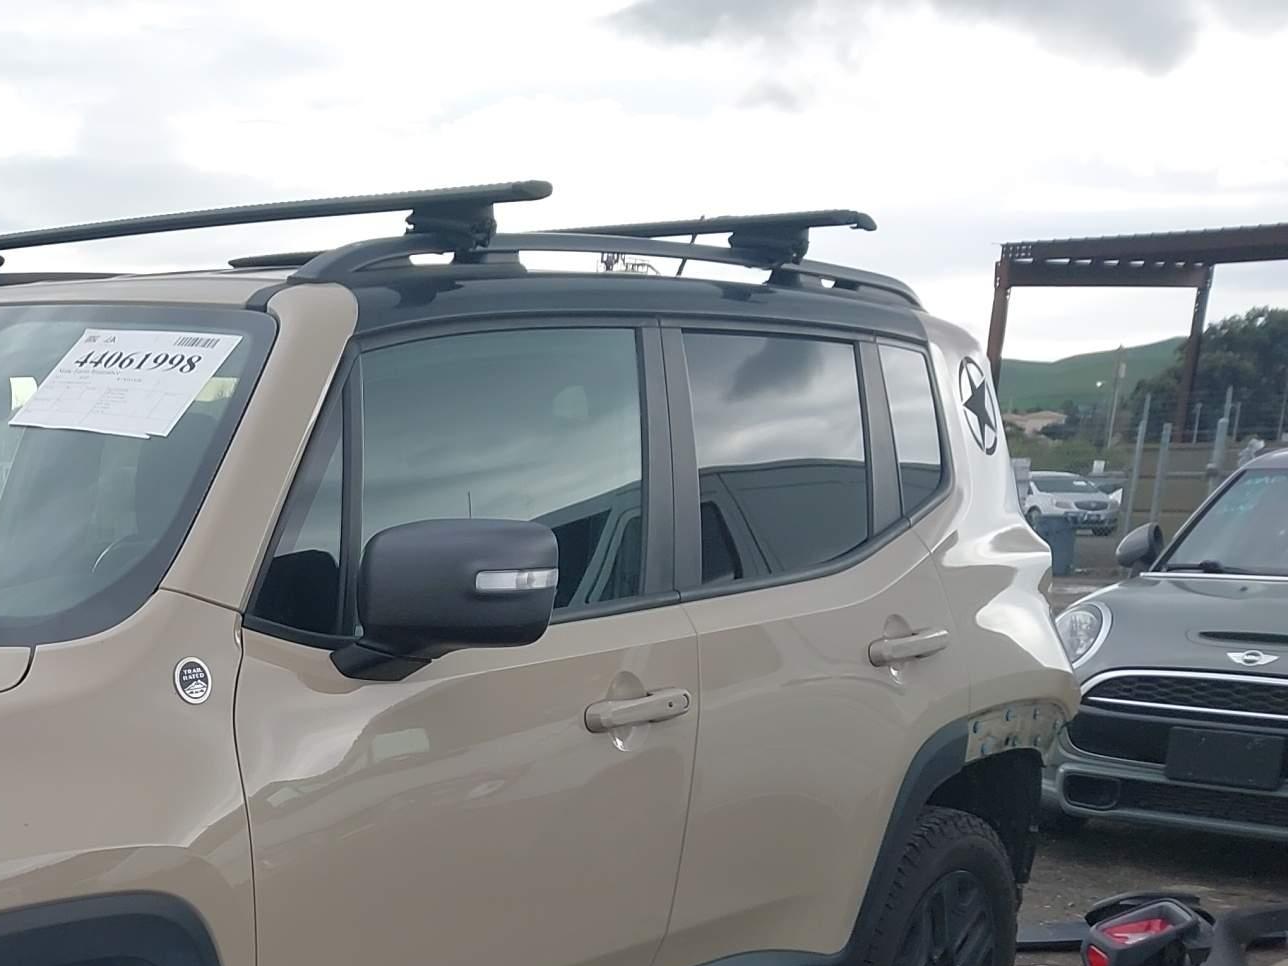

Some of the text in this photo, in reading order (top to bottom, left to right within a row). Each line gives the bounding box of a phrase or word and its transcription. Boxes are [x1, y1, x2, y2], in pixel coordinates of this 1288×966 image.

[74, 350, 204, 375] 44061998
[183, 667, 203, 675] TRAIL
[182, 672, 205, 681] RATED
